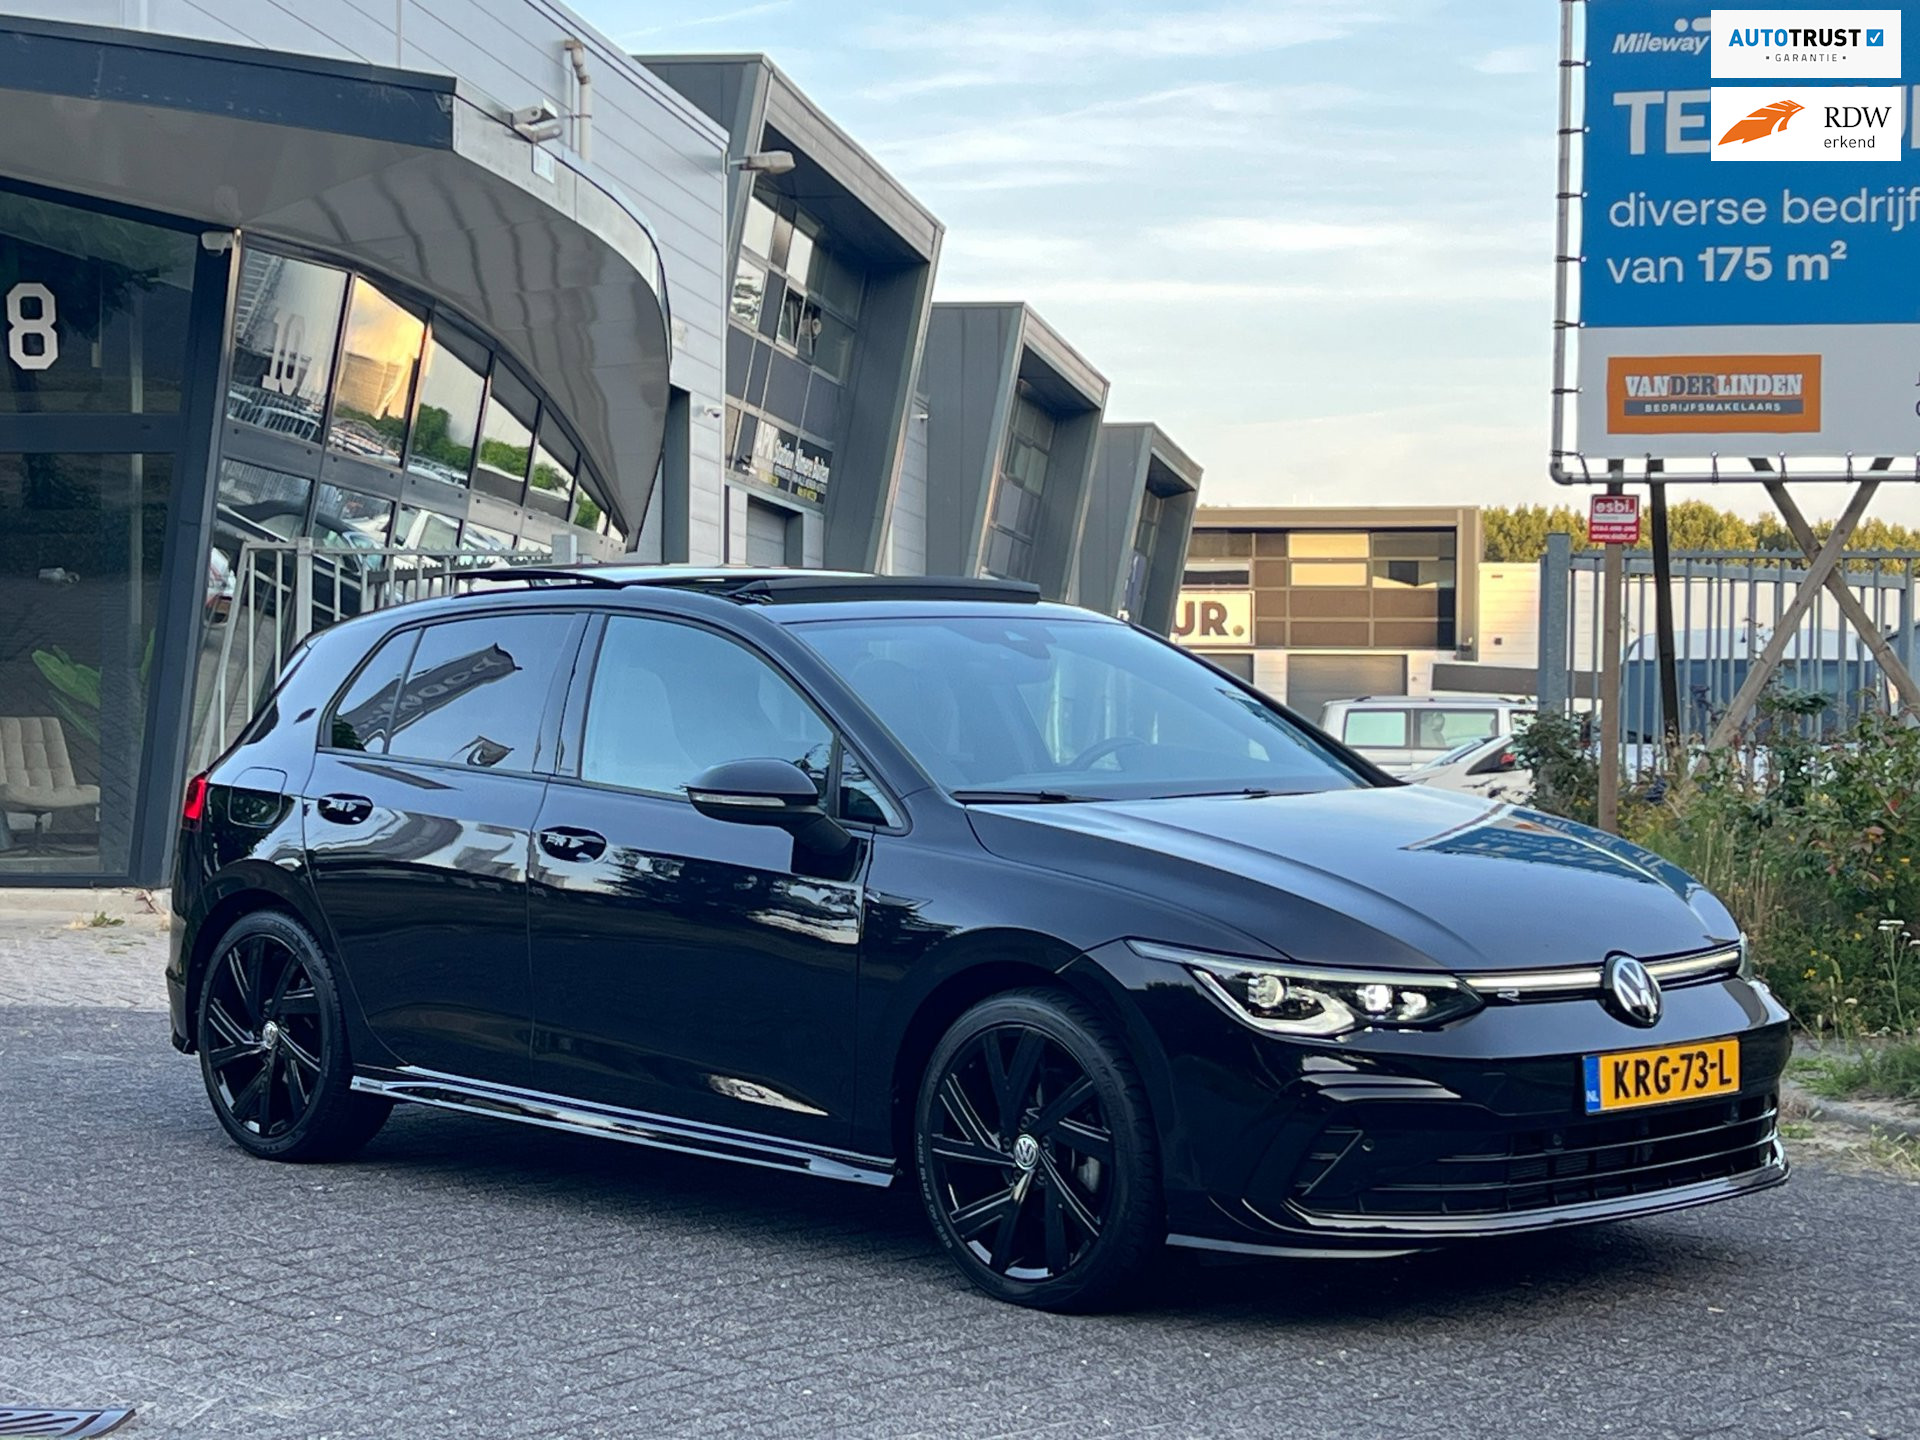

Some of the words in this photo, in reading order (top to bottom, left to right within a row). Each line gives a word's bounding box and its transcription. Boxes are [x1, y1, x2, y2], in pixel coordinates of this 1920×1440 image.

[1612, 32, 1710, 56] Mileway
[1609, 192, 1767, 227] diverse
[1606, 256, 1684, 284] van
[1698, 246, 1773, 282] 175
[1787, 240, 1848, 281] m²
[6, 282, 59, 371] 8
[262, 307, 305, 397] 10
[1645, 402, 1781, 413] BEDRIJFSMAKELAARS
[1614, 1048, 1732, 1099] KRG-73-L
